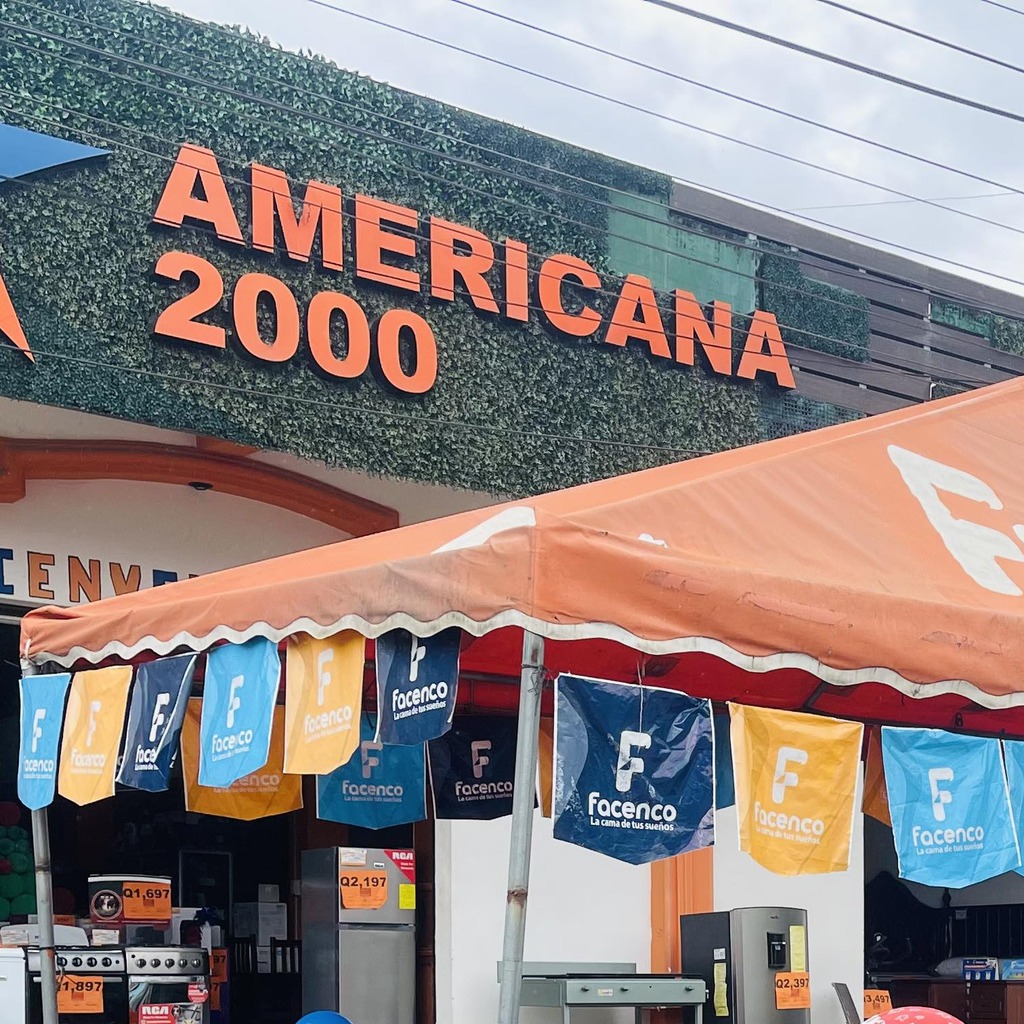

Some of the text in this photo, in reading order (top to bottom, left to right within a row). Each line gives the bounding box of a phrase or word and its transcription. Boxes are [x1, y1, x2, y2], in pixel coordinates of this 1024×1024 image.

[153, 143, 796, 389] AMERICANA
[153, 251, 438, 394] 2000
[392, 681, 449, 711] facenco
[23, 756, 54, 773] acenco
[615, 730, 652, 792] F
[772, 746, 809, 804] F
[342, 780, 404, 797] facenco
[455, 781, 513, 797] facenco
[928, 767, 954, 821] F
[588, 791, 677, 822] facenco
[590, 816, 674, 831] La cama de tus sueños
[754, 801, 825, 835] facenco
[912, 825, 985, 847] facenco
[392, 852, 414, 860] RCA
[916, 847, 925, 856] La
[925, 846, 943, 854] cama
[944, 845, 953, 853] de
[340, 876, 387, 889] Q2,197
[123, 888, 170, 900] Q1,697
[57, 981, 102, 993] 1,897
[776, 978, 809, 989] Q2,397
[864, 994, 890, 1004] 3,497
[141, 1006, 169, 1015] RCA
